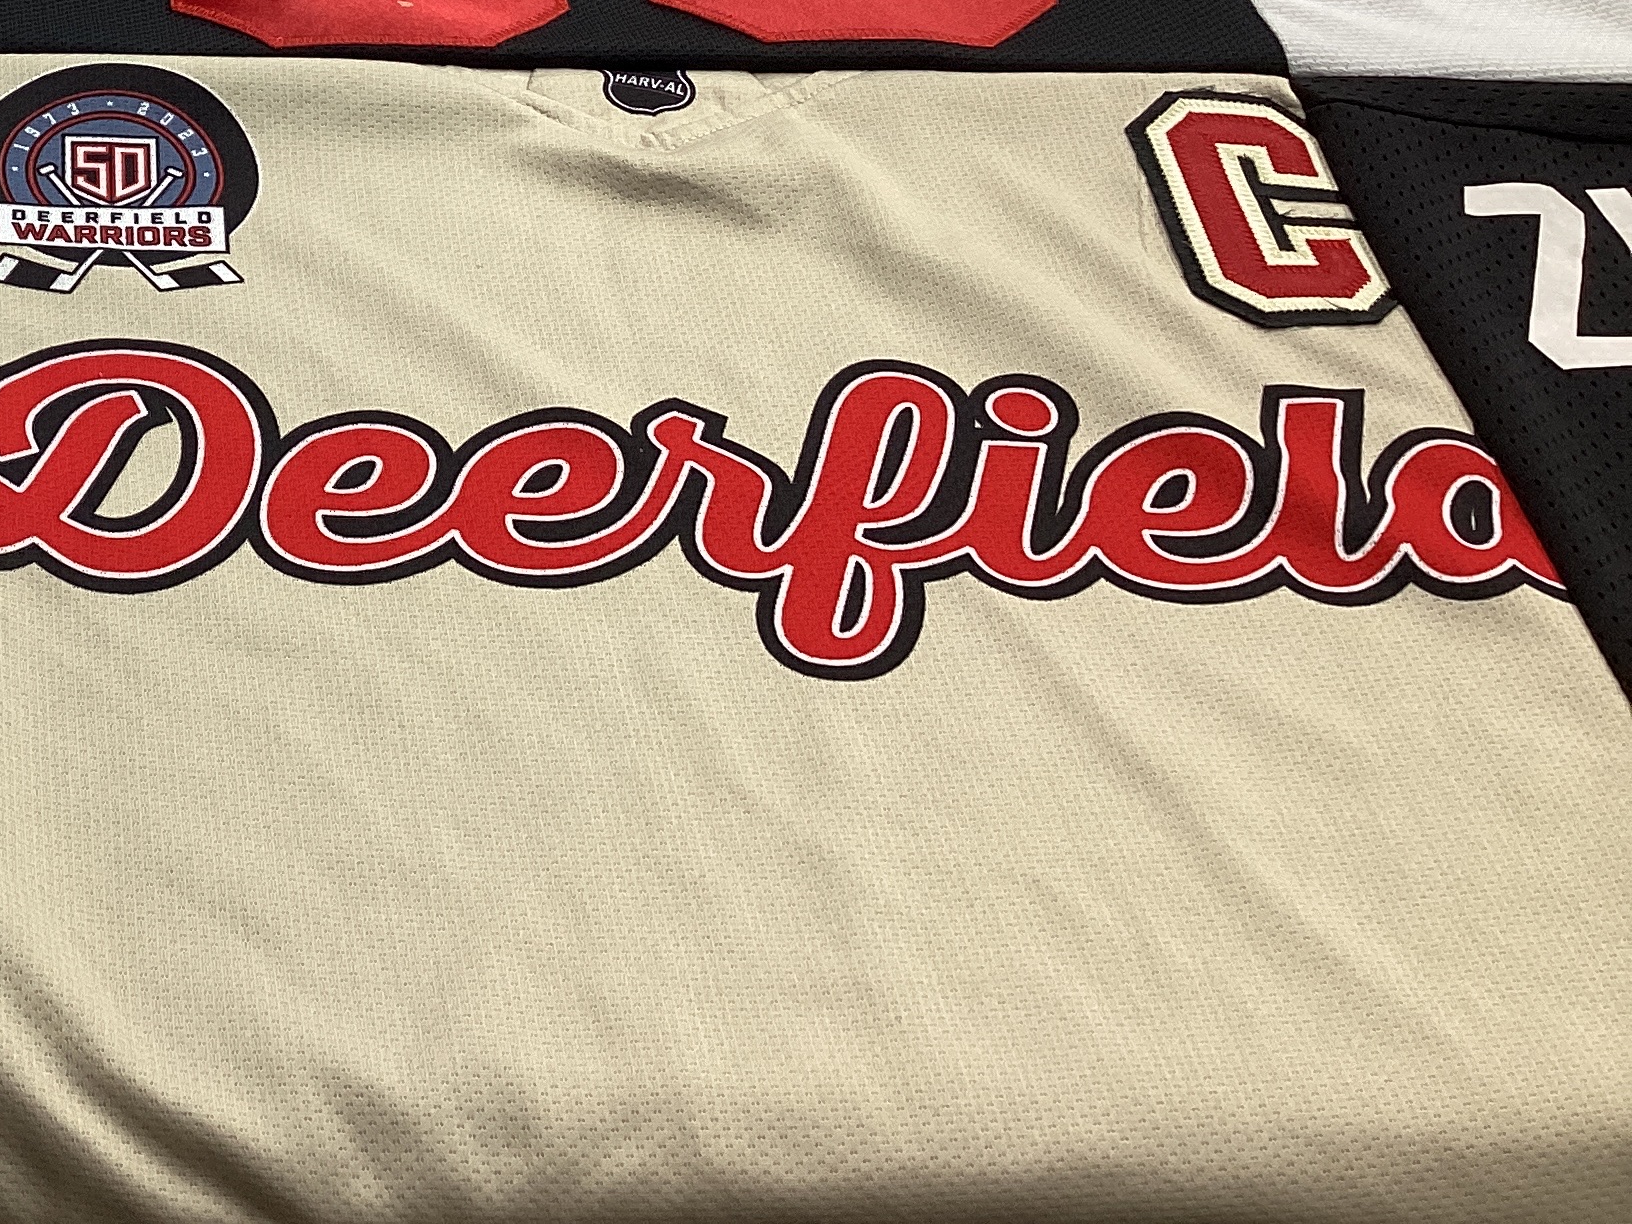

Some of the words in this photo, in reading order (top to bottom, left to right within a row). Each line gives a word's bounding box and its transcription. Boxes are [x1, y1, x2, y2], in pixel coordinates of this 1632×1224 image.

[614, 73, 685, 96] HARV-AL
[11, 209, 212, 226] DEERFIELD
[1125, 91, 1398, 328] C
[11, 222, 213, 248] WARRIORS
